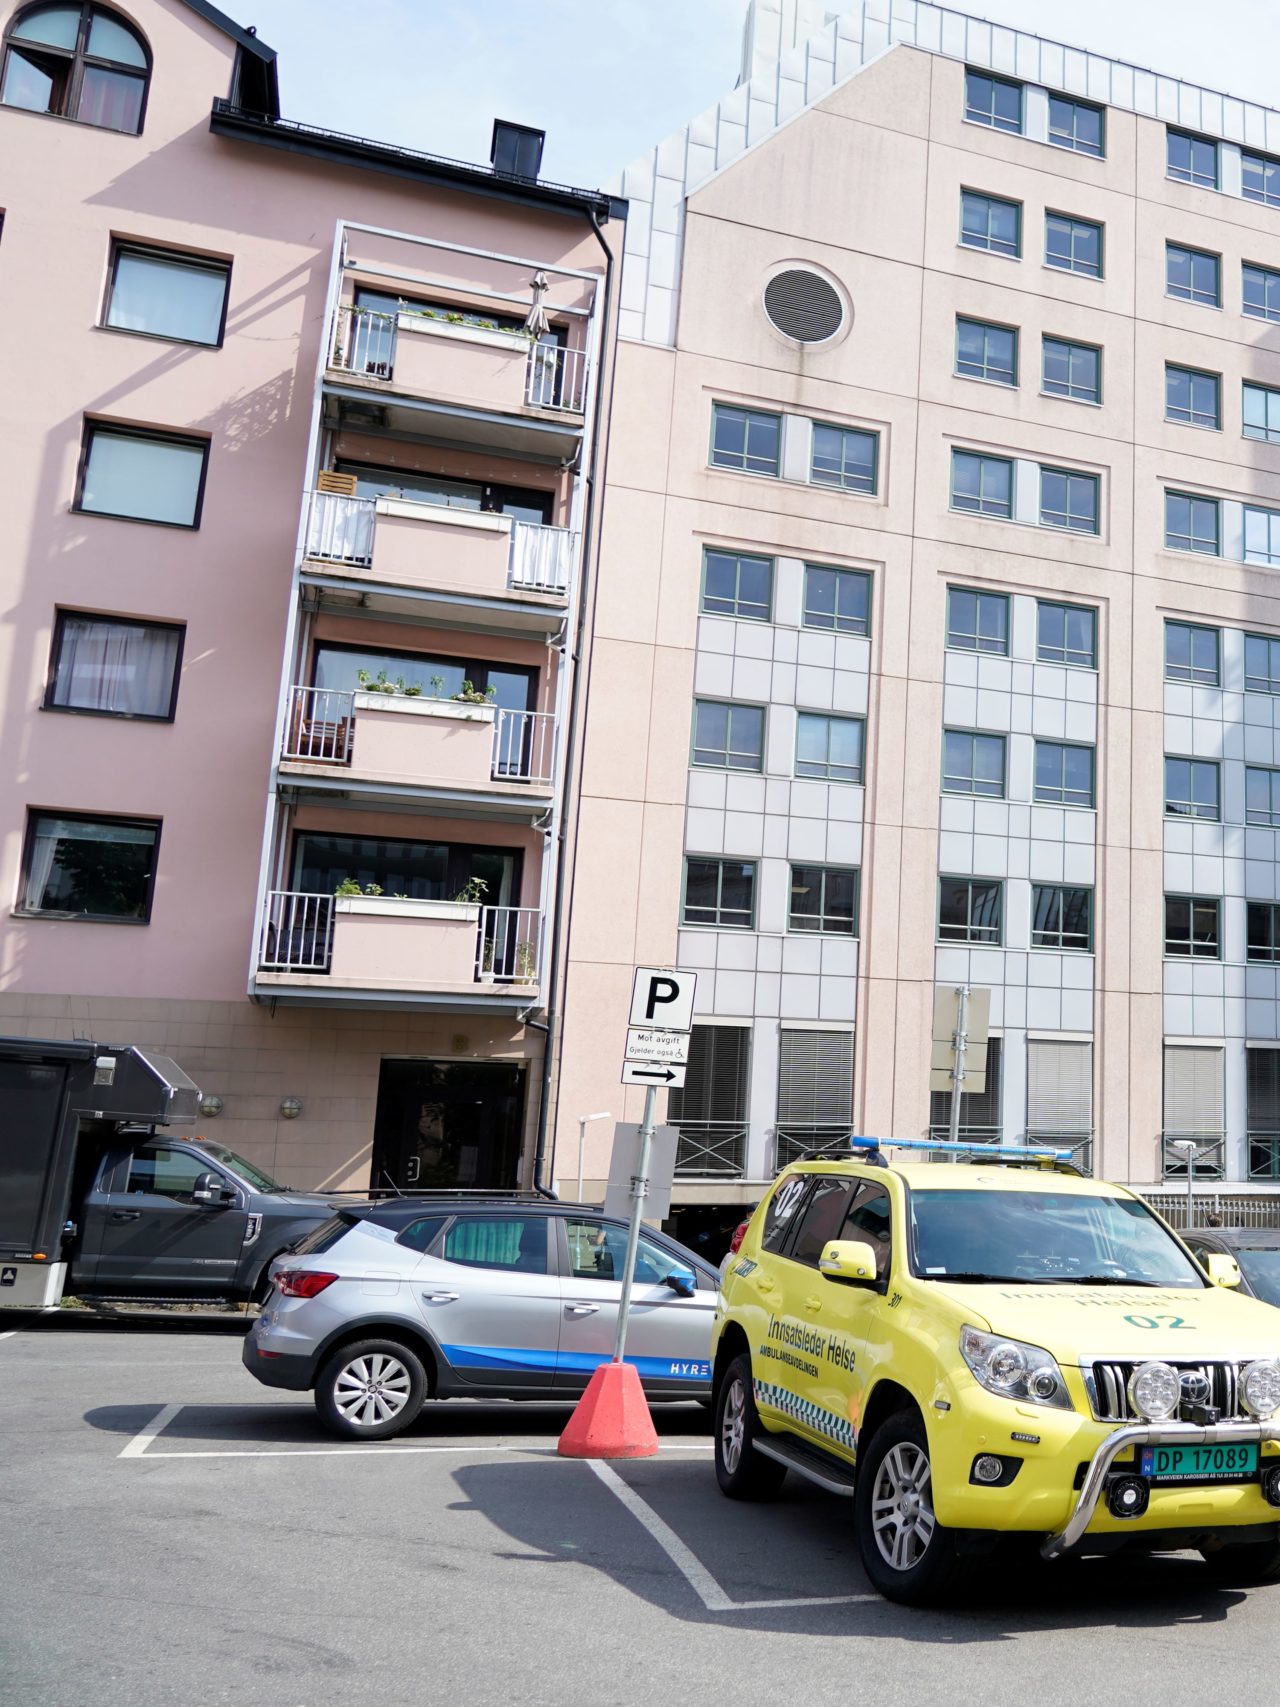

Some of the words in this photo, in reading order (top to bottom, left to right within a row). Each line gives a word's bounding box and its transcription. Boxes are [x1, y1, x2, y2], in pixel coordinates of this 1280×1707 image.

[645, 976, 680, 1019] P
[637, 1034, 653, 1043] Mot
[655, 1036, 681, 1045] avgift
[629, 1046, 655, 1056] Gjelder
[774, 1180, 805, 1218] 02
[1000, 1292, 1201, 1301] Innsatsleder
[1074, 1299, 1169, 1307] Helse
[1123, 1315, 1198, 1329] 02
[767, 1312, 826, 1359] Innsatsleder
[826, 1334, 856, 1373] Helse
[670, 1363, 709, 1376] HYRE
[1144, 1464, 1151, 1472] N
[1155, 1450, 1183, 1473] DP
[1193, 1448, 1249, 1471] 17089
